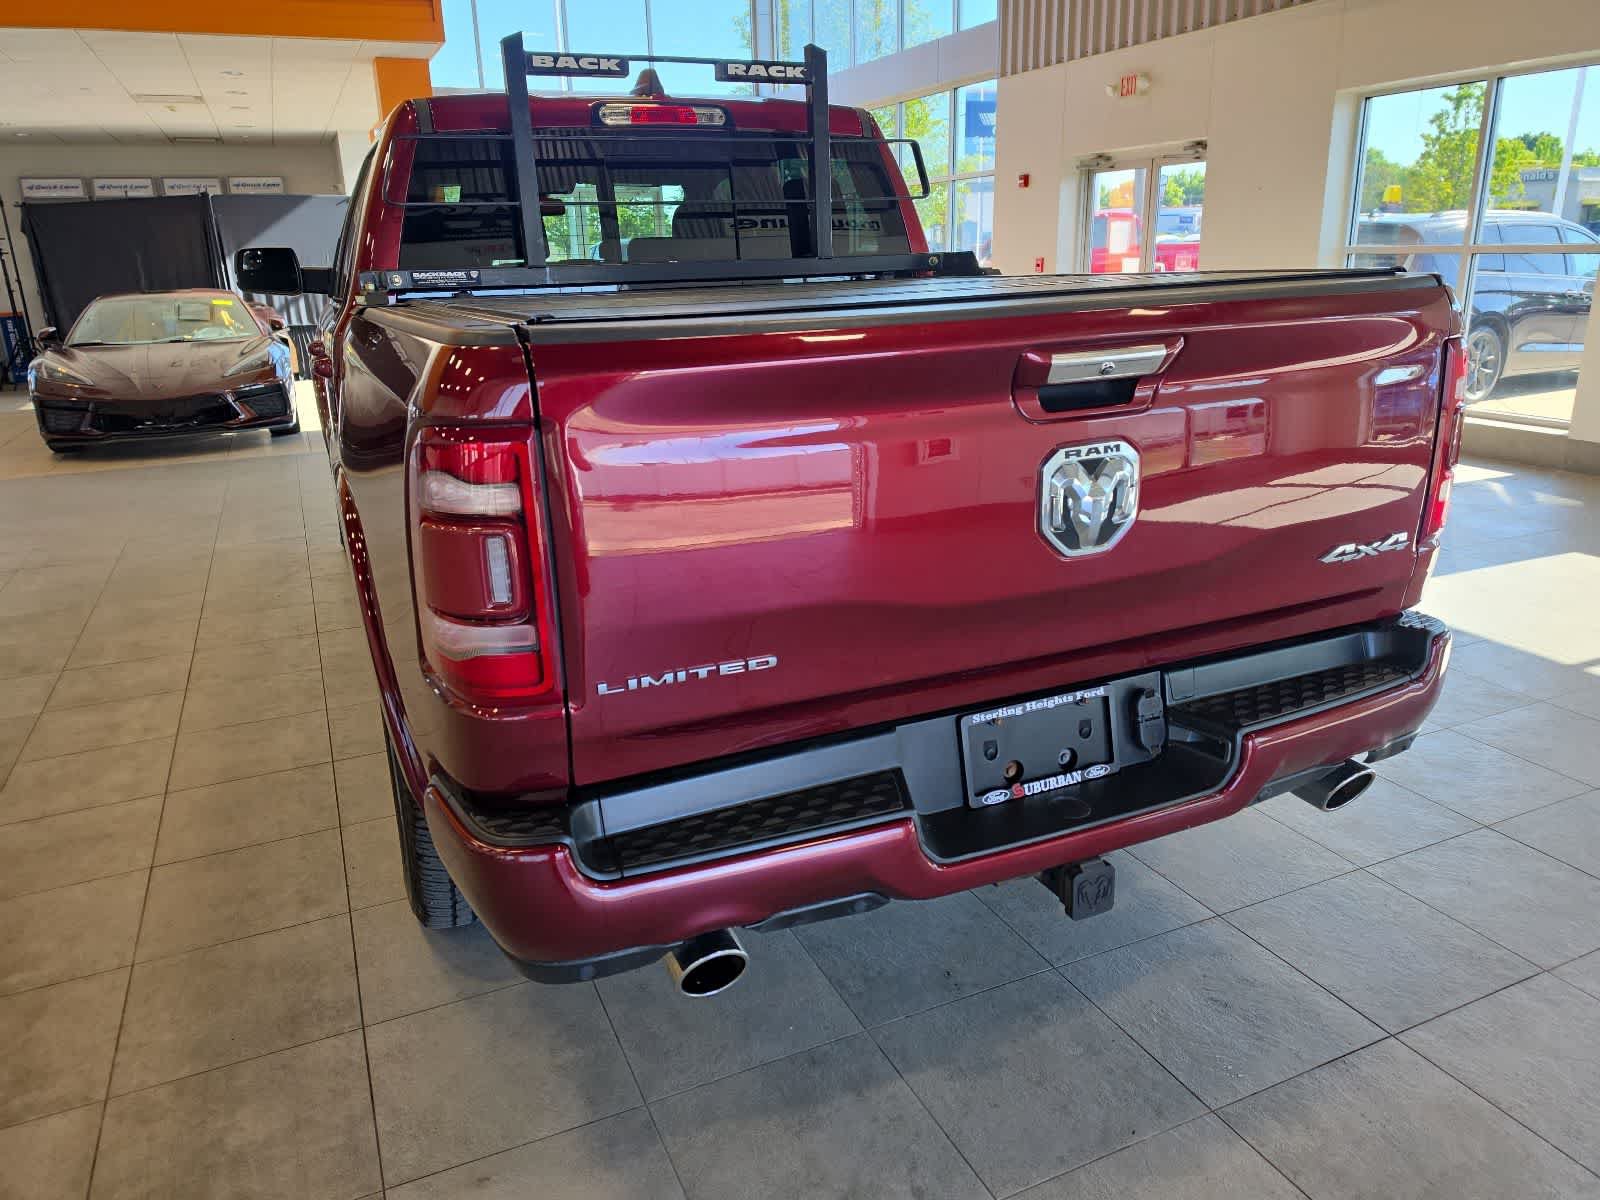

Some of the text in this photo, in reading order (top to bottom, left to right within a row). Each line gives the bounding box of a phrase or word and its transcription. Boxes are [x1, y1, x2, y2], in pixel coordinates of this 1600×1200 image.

[532, 55, 808, 78] BACK RACK
[1120, 75, 1137, 97] EXIT
[1064, 444, 1121, 459] RAM
[597, 654, 778, 696] LIMITED
[972, 686, 1105, 724] Sterling Heights Ford
[985, 765, 1108, 803] Ford SUBURBAN Ford
